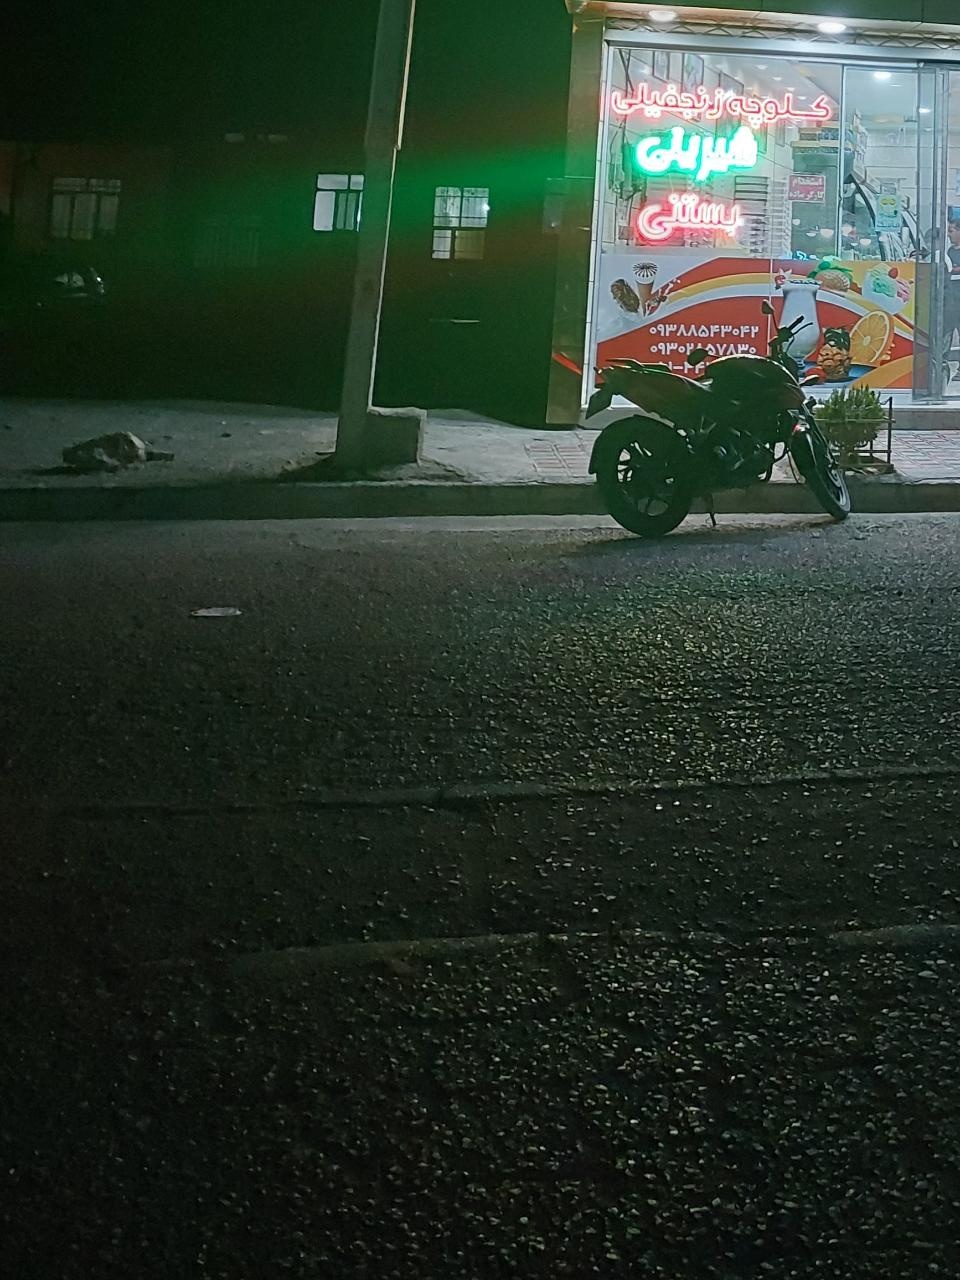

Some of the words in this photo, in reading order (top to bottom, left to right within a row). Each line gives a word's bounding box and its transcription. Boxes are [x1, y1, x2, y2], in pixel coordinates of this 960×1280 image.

[612, 83, 725, 119] زنجفیلی
[726, 91, 832, 129] کلوچه
[637, 193, 744, 241] بستنی
[649, 323, 759, 338] ۰۹۳۸۸۵۴۳۰۴۲
